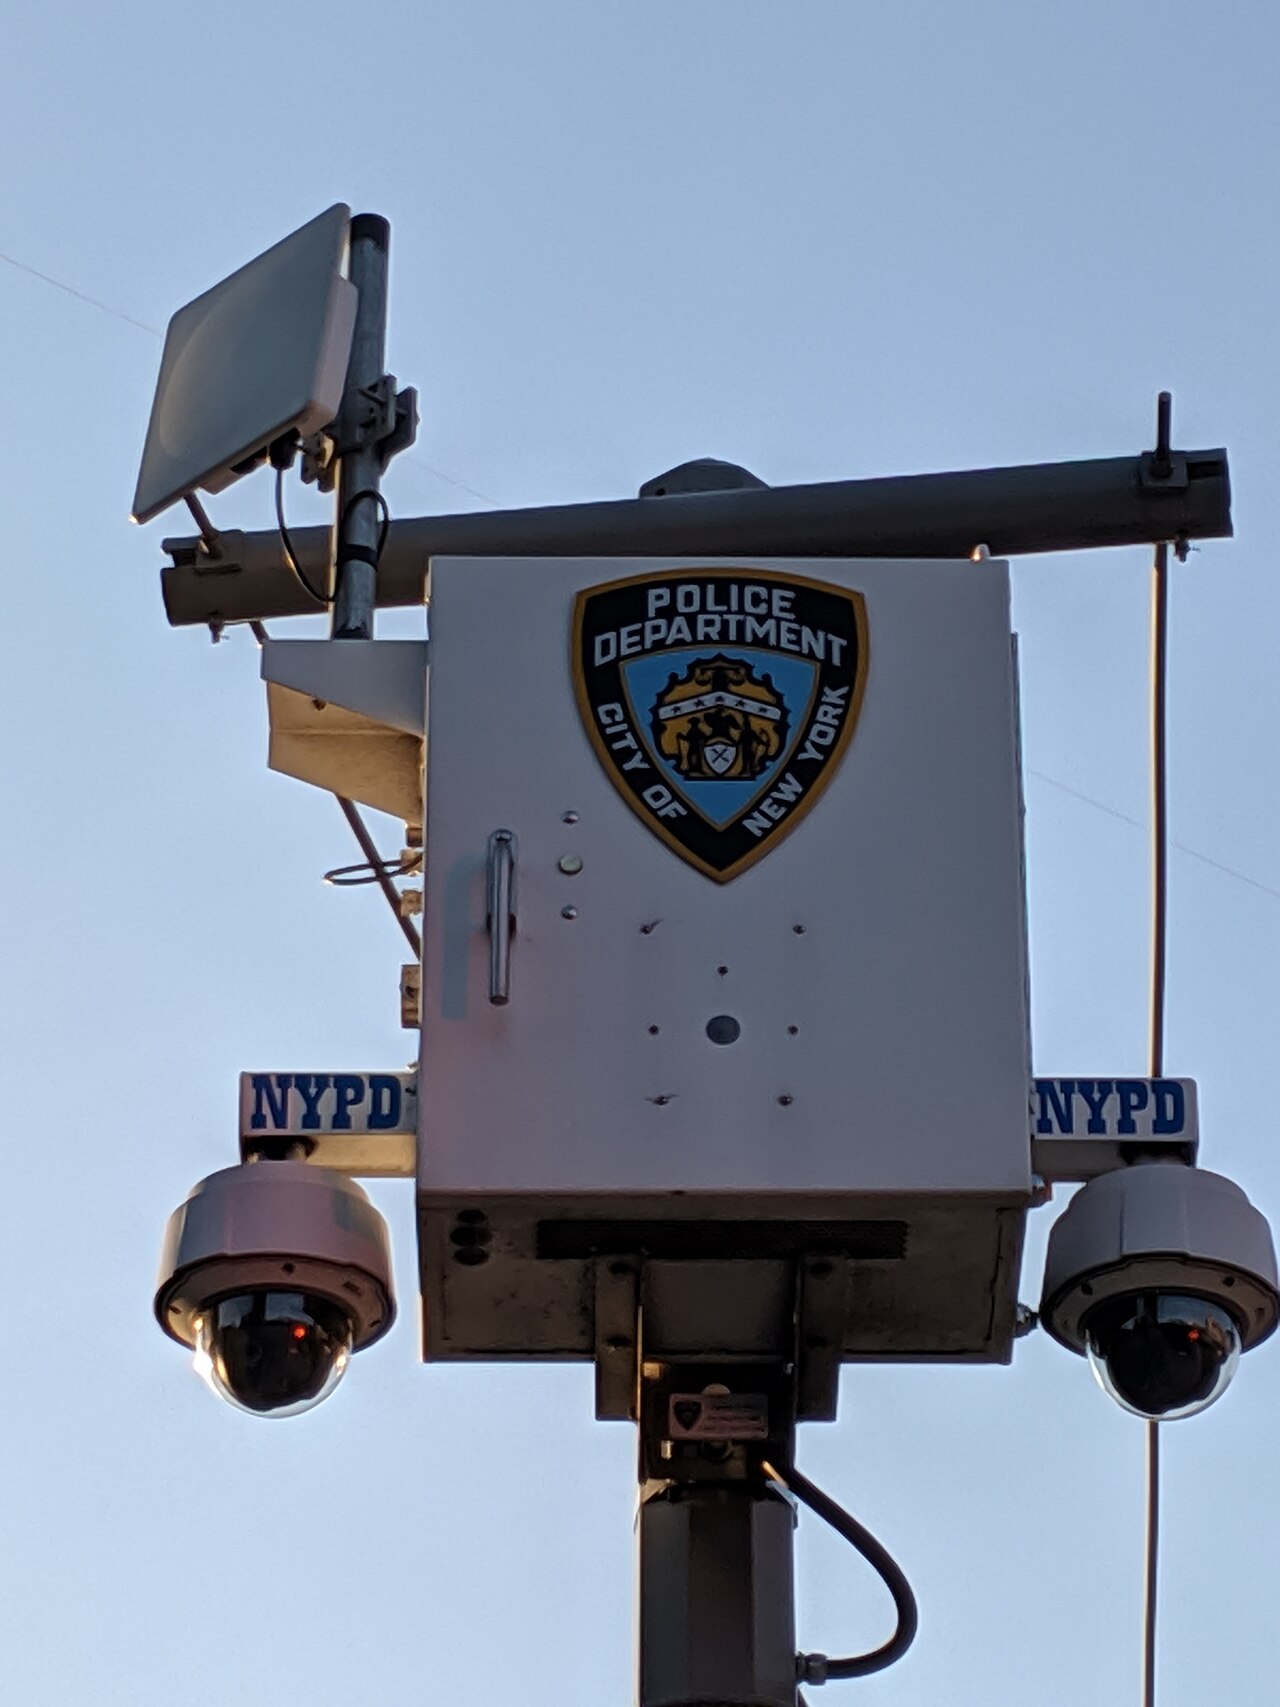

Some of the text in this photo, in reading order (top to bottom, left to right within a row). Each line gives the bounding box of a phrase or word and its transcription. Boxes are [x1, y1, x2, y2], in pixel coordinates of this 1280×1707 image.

[647, 584, 796, 619] POLICE
[594, 614, 847, 667] DEPARTMENT
[597, 702, 687, 820] CITY OF
[742, 685, 849, 837] NEW YORK
[251, 1075, 401, 1129] NYPD
[1035, 1081, 1184, 1134] NYPD
